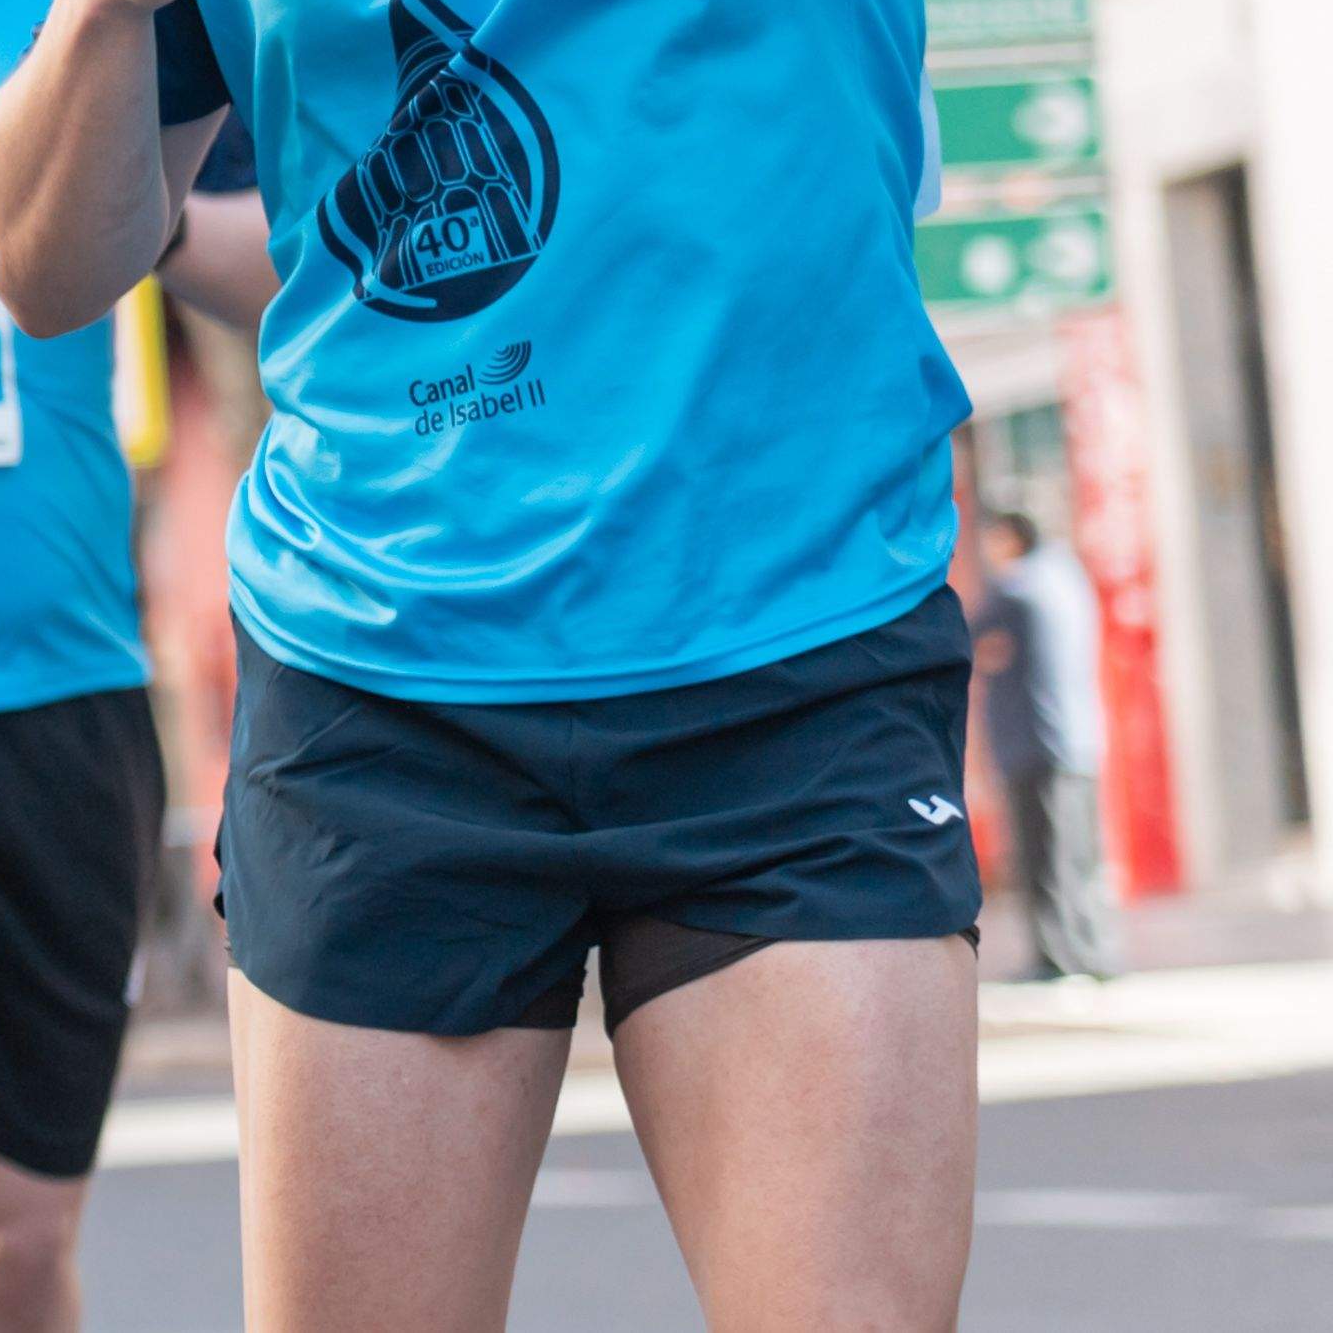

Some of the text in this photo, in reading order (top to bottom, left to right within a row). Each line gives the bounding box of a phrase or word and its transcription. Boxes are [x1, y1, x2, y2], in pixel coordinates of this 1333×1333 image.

[425, 252, 485, 277] EDICIÓN
[408, 364, 476, 407] Canal
[414, 409, 444, 437] de
[449, 384, 524, 428] Isabel
